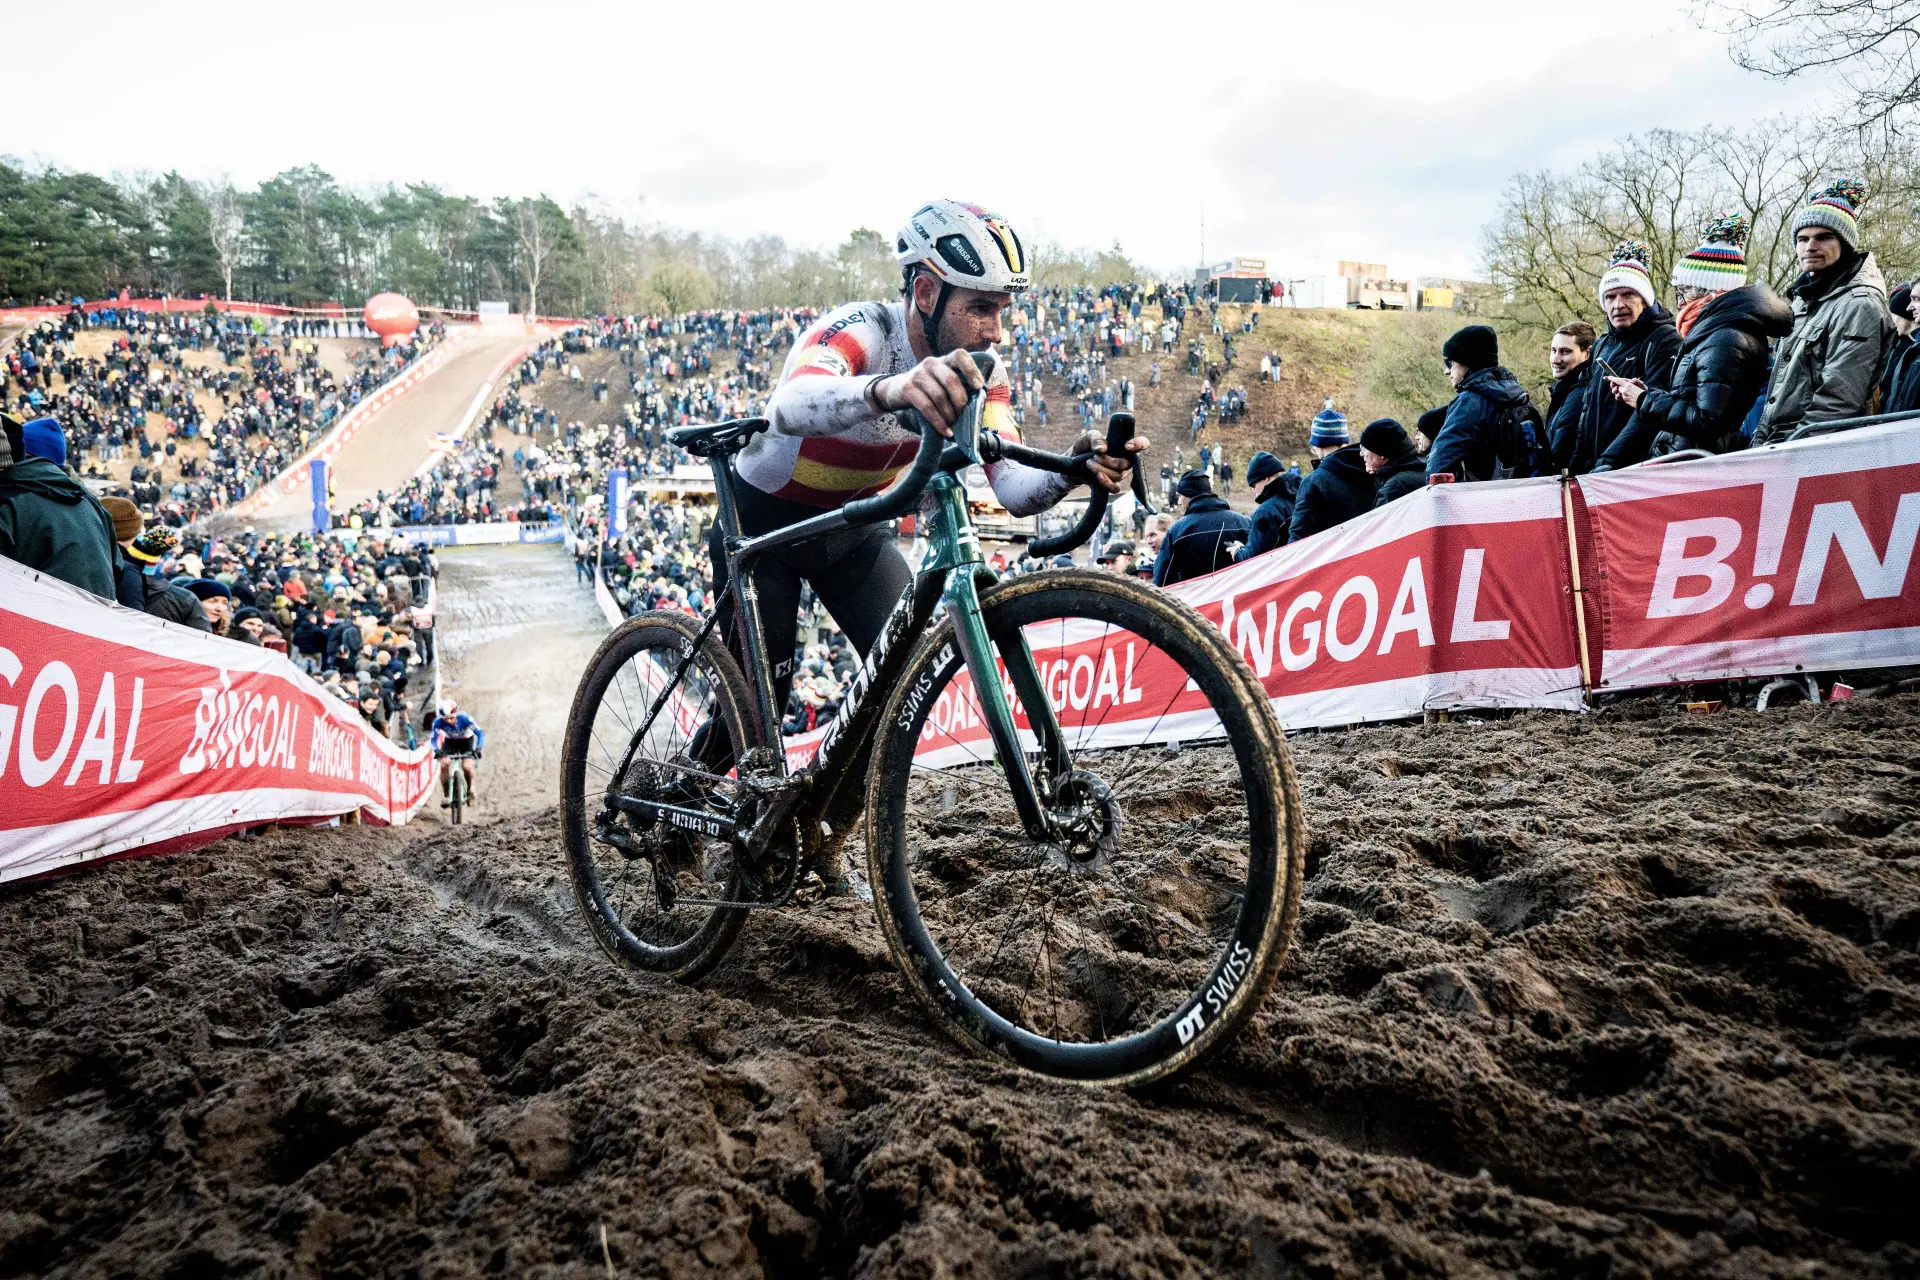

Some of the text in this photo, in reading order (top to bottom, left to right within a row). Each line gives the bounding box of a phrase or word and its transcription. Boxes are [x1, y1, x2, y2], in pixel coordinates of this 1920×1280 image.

[956, 243, 980, 273] DISBAIN
[818, 310, 866, 347] RIDLEY
[898, 641, 955, 731] DT SWISS
[1175, 940, 1252, 1045] DT SWISS
